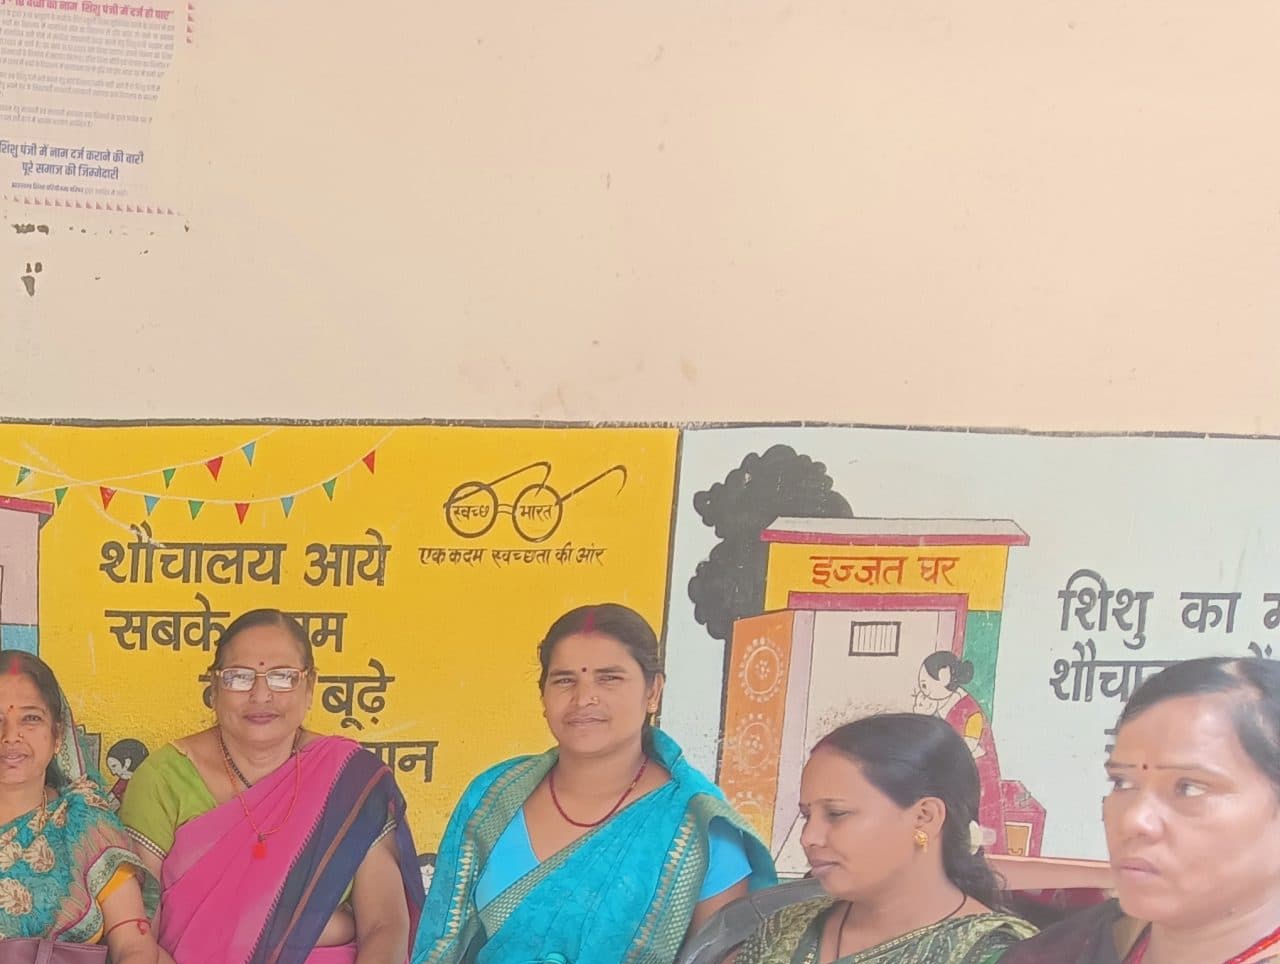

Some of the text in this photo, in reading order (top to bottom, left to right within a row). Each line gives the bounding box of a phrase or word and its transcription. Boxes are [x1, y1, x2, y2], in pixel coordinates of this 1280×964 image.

[81, 1, 101, 16] शिशु
[20, 142, 37, 157] पंजी
[39, 144, 48, 157] में
[50, 146, 69, 159] नाम
[70, 145, 85, 161] दर्ज
[86, 148, 110, 162] कराने
[112, 149, 124, 163] की
[22, 160, 119, 180] पूरे समाज की जिम्मेदारी
[452, 504, 554, 522] स्वच्छ भारत
[99, 520, 392, 587] शौचालय आये
[490, 548, 551, 568] स्वच्छता
[552, 541, 576, 566] की
[918, 556, 960, 587] घर
[104, 592, 231, 652] सबके
[1057, 568, 1155, 650] शिशु
[1179, 591, 1242, 633] का
[318, 658, 395, 731] बूढ़े
